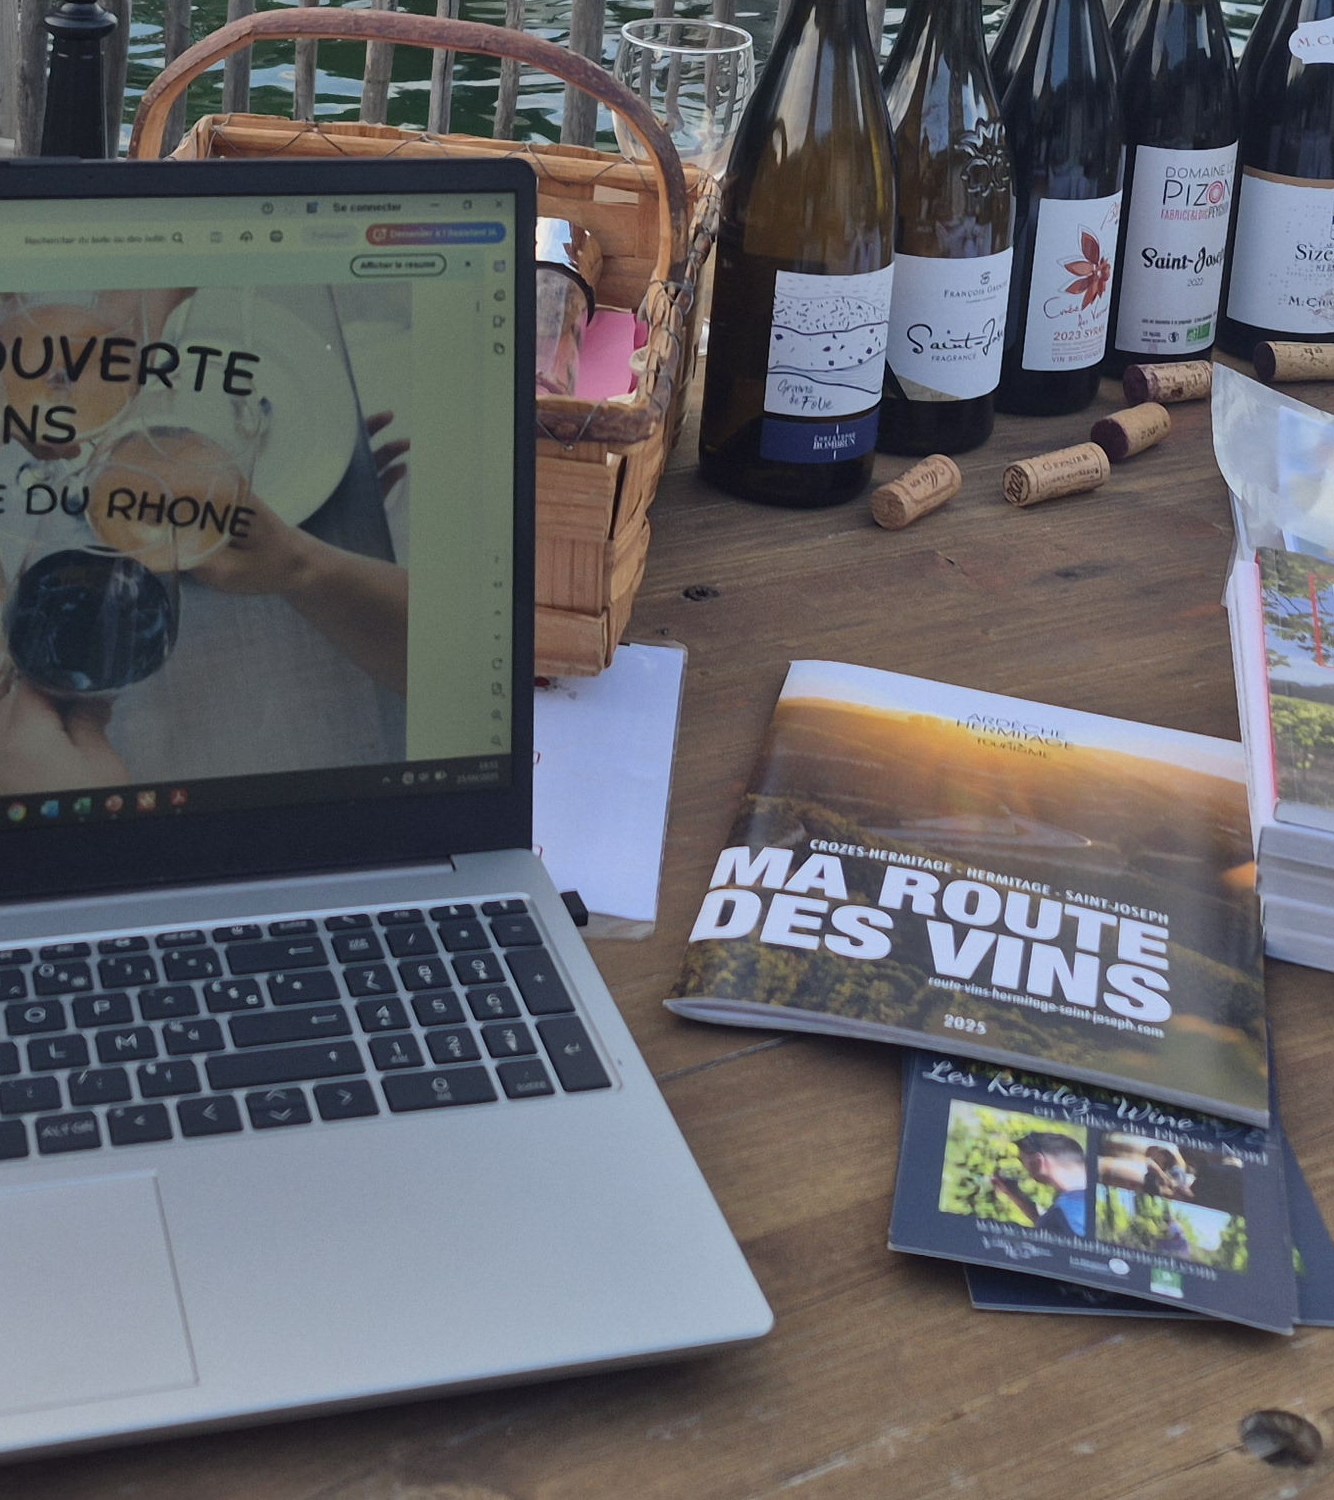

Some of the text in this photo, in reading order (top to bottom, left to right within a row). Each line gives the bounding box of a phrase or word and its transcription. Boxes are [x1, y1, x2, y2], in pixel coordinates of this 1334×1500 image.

[1165, 164, 1226, 180] DOMAINE
[1162, 176, 1233, 207] PIZON
[943, 287, 985, 299] FRANÇOIS
[1053, 330, 1081, 342] 2023
[931, 352, 977, 363] FRAGRANCE
[1006, 467, 1025, 499] 2024
[25, 484, 89, 516] DU
[106, 486, 257, 539] RHONE
[956, 718, 1073, 750] HERMITAGE
[967, 713, 1066, 740] ARDÈCHE
[976, 737, 1051, 760] TOURISME
[809, 838, 1169, 925] CROZES-HERMITAGE HERMITAGE SAINT-JOSEPH
[708, 846, 1169, 971] MA ROUTE
[689, 888, 1173, 1023] DES VINS
[93, 999, 110, 1016] P
[943, 1013, 987, 1036] 2025
[48, 1042, 66, 1059] L
[115, 1033, 138, 1050] M
[922, 1060, 977, 1088] Les
[1033, 1106, 1055, 1120] en
[1122, 1119, 1148, 1137] du
[1220, 1141, 1269, 1166] Nord
